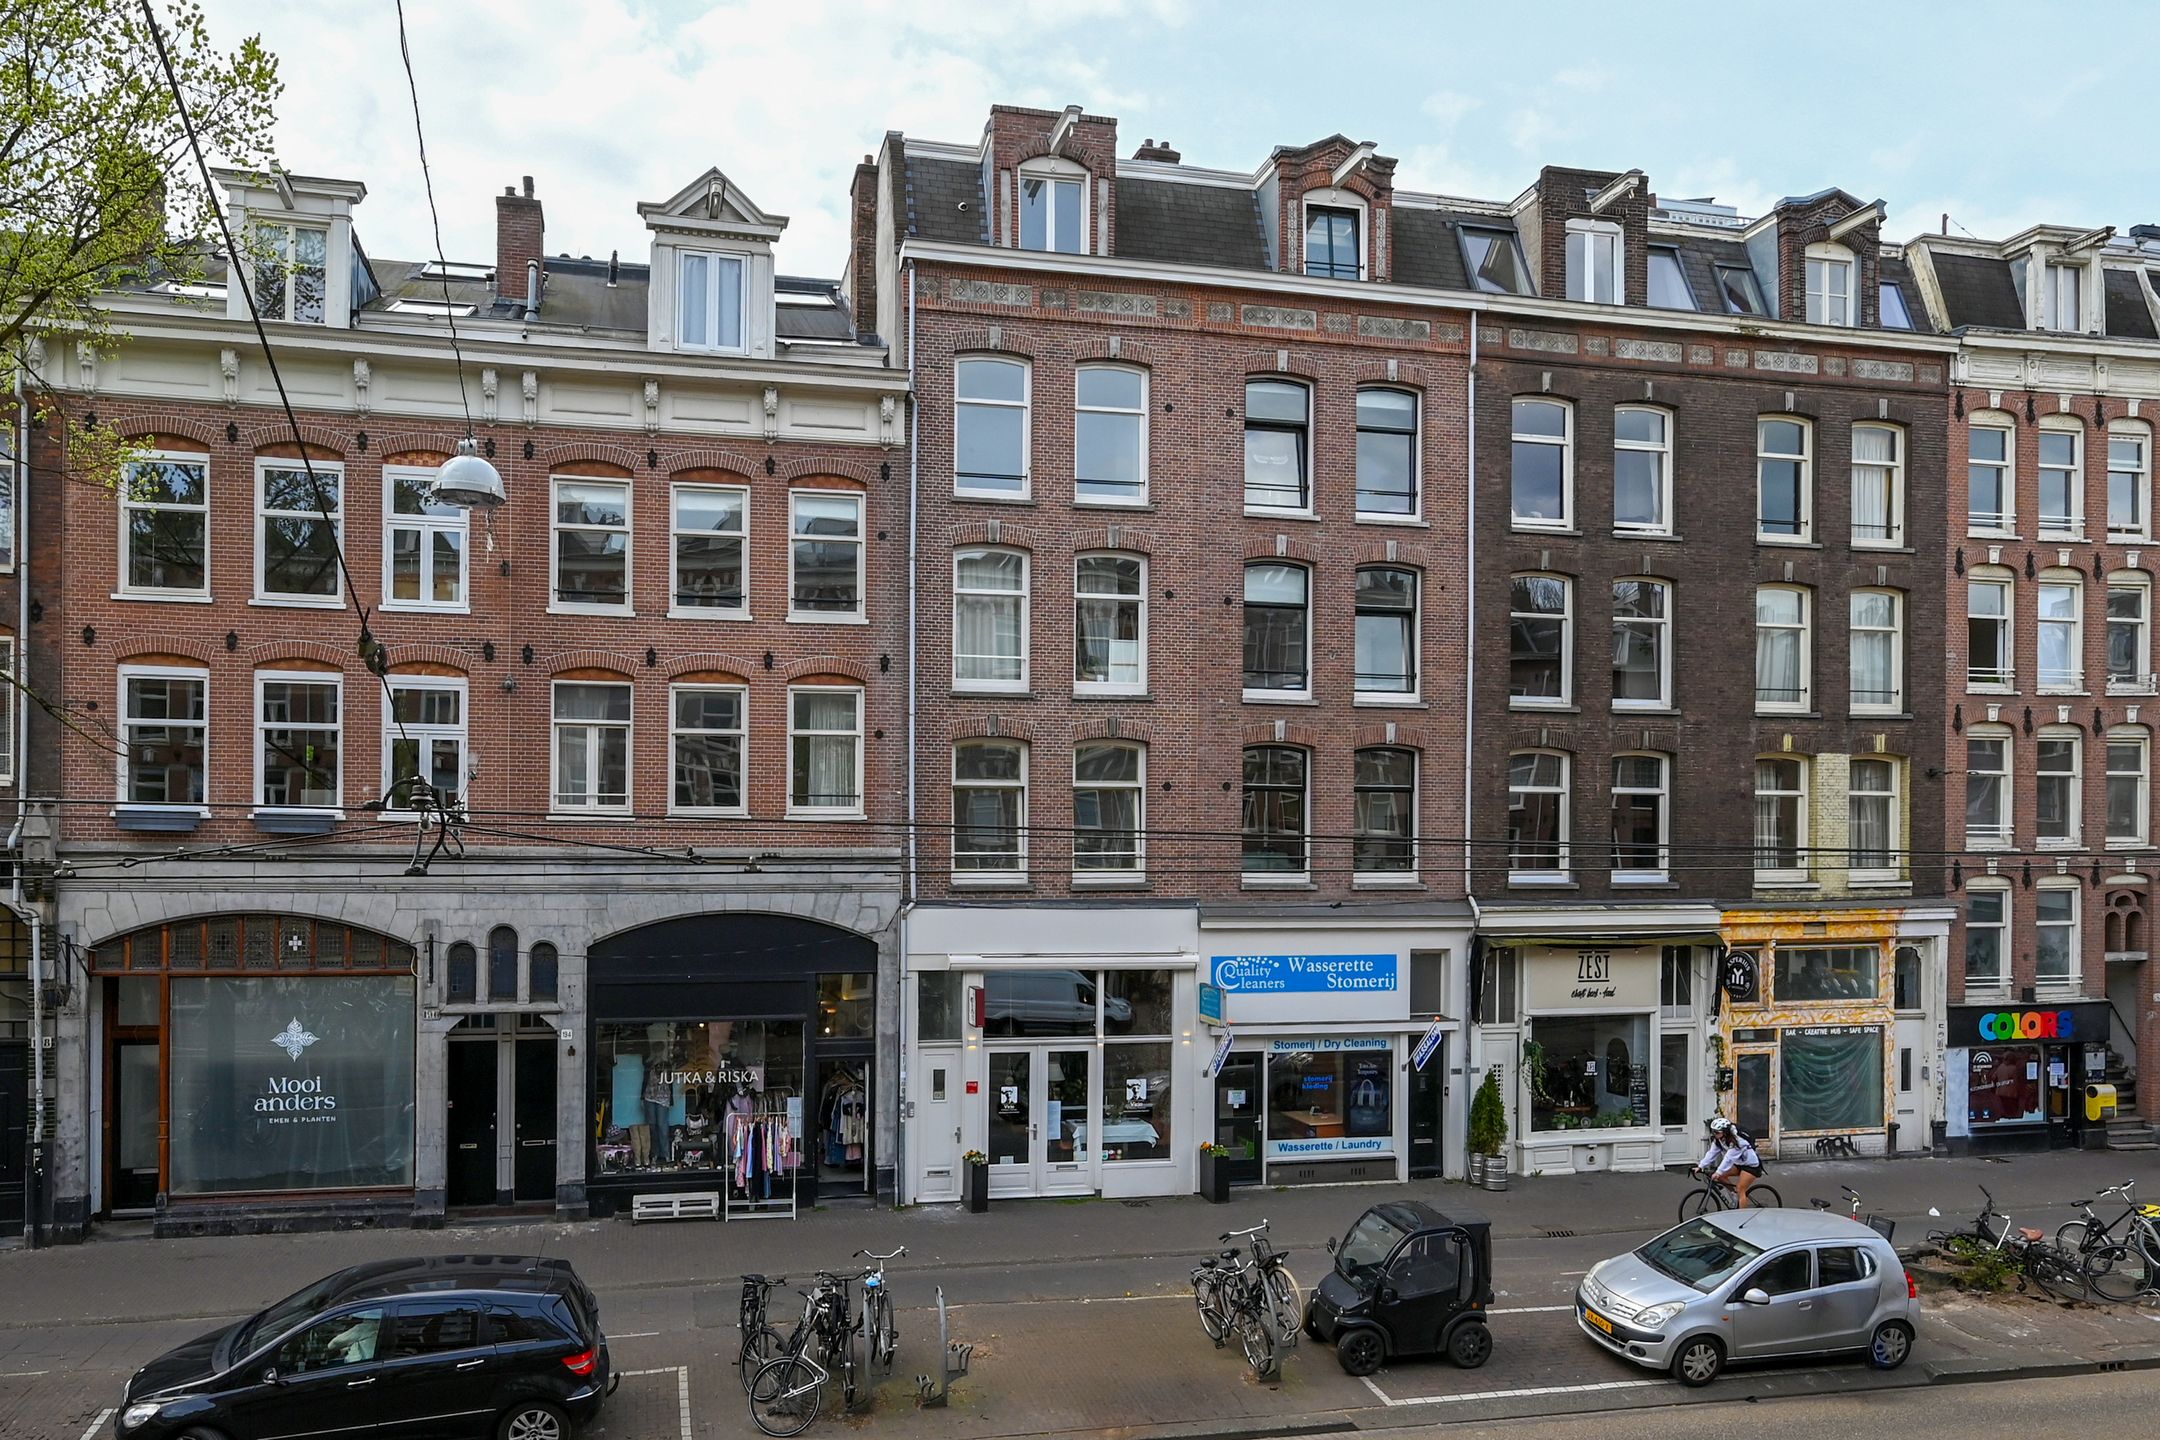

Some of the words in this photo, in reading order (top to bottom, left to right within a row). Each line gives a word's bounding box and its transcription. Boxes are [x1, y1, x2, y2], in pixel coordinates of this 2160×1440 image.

[1224, 964, 1271, 979] Quality
[1288, 957, 1374, 973] Wasserette
[1578, 955, 1610, 979] ZEST
[1216, 960, 1285, 990] Cleaners
[1327, 972, 1395, 991] Stomerij
[1805, 1028, 1828, 1036] CREATIVE
[1864, 1026, 1879, 1034] SPACE
[1978, 1010, 2074, 1041] COLORS
[1273, 1039, 1315, 1050] Stomerij
[1324, 1039, 1340, 1050] Dry
[1344, 1037, 1387, 1049] Cleaning
[268, 1075, 322, 1094] Mooi
[659, 1071, 702, 1085] JUTKA
[705, 1071, 716, 1083] &
[719, 1070, 759, 1083] RISKA
[254, 1093, 336, 1112] anders
[1278, 1142, 1333, 1152] Wasserette
[1342, 1139, 1382, 1150] Laundry
